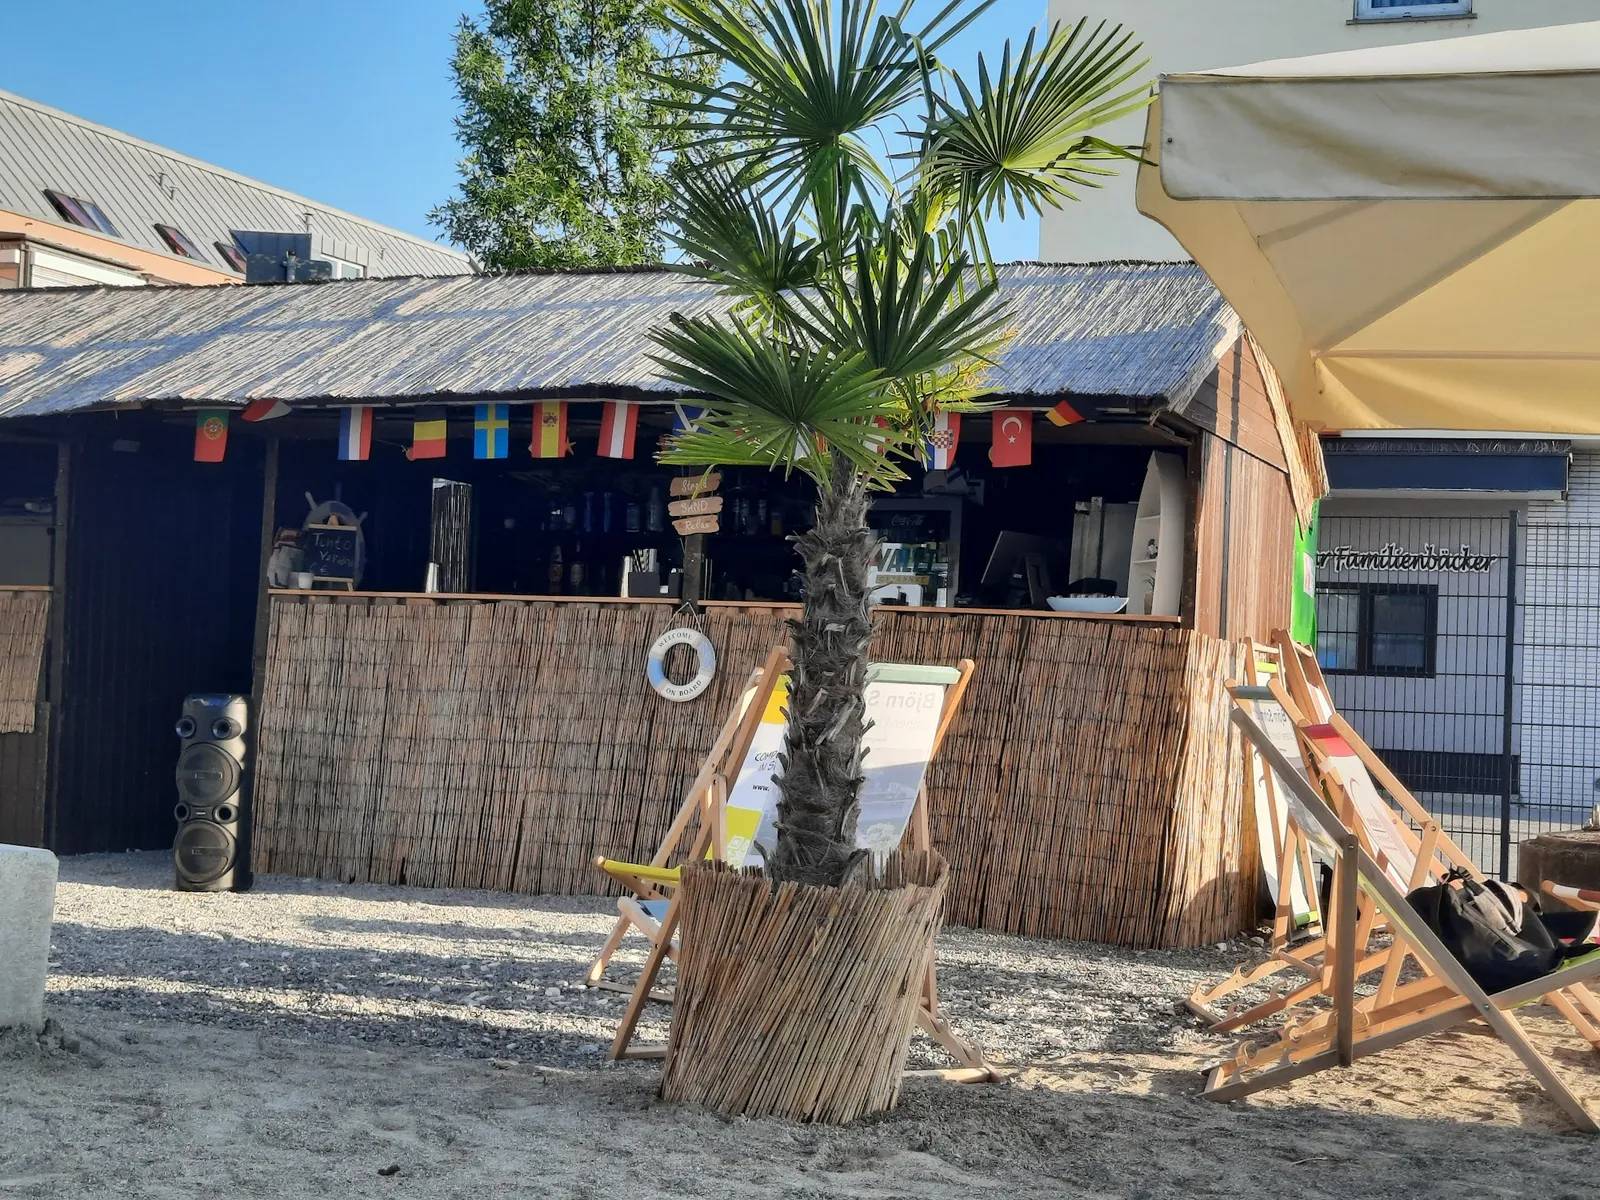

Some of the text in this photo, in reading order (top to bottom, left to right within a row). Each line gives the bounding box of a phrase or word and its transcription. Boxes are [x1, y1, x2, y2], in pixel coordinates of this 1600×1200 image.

[681, 479, 708, 493] Strad
[680, 501, 708, 513] SAND
[1334, 543, 1497, 573] Familienbäcker
[658, 632, 694, 648] WELCOME
[665, 679, 702, 697] ON BOARD
[754, 750, 778, 762] COMP
